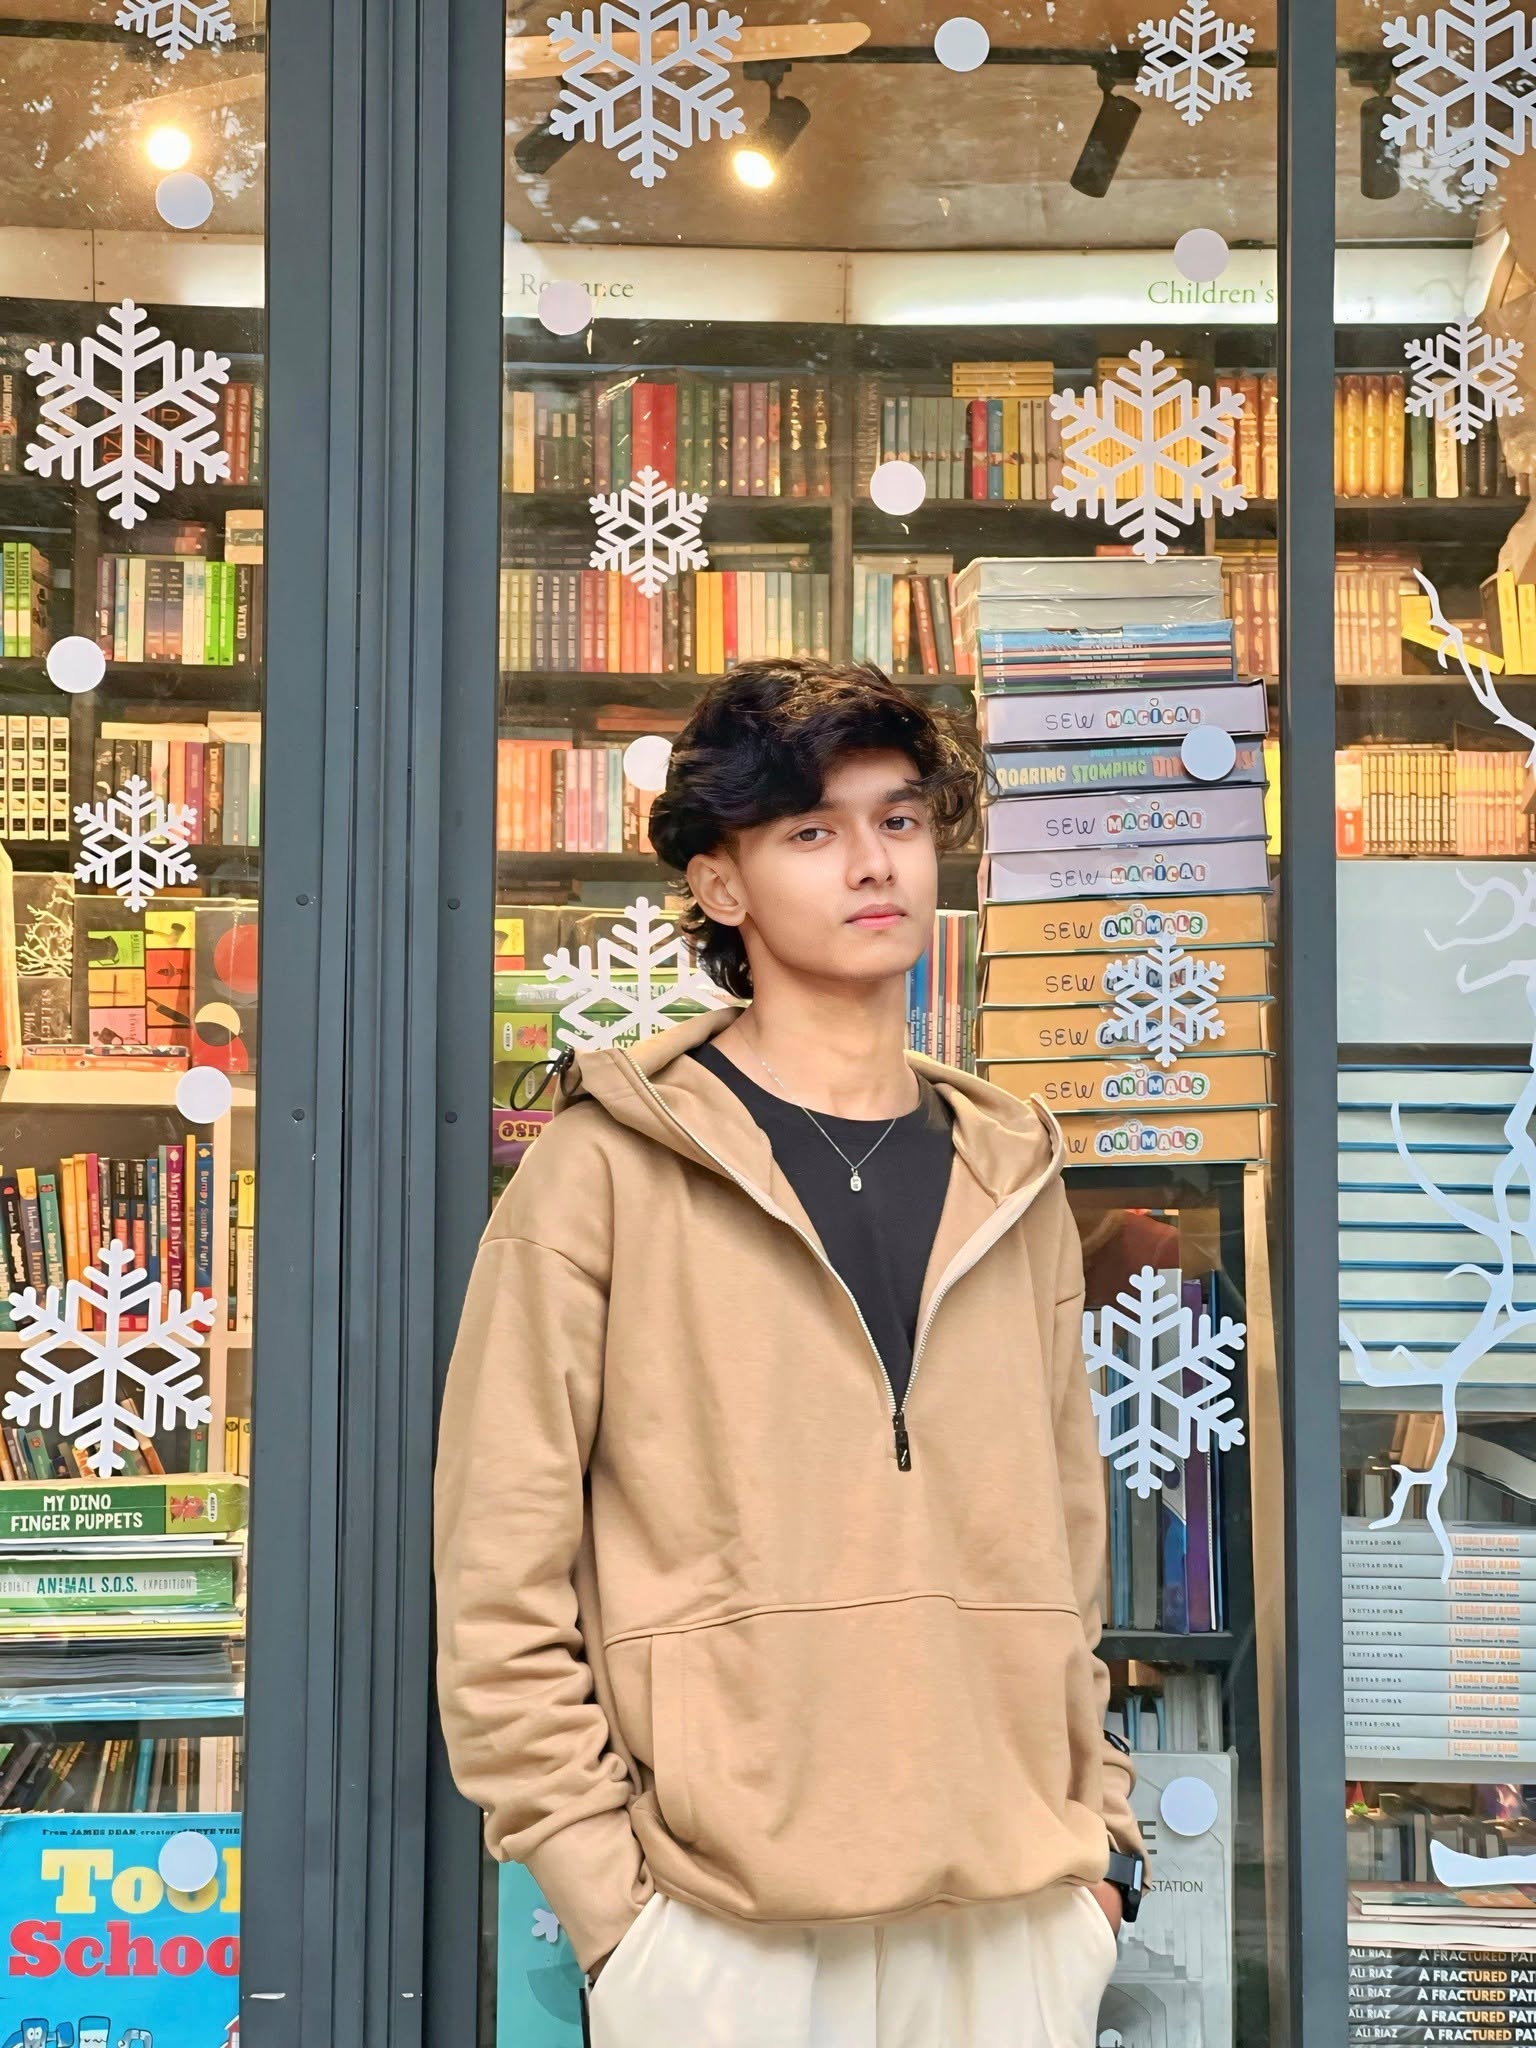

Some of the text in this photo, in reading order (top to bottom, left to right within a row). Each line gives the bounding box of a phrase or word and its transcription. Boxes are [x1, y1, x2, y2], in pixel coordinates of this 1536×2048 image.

[1147, 280, 1275, 304] Children's
[1045, 698, 1201, 730] SEW MAGICAL
[1071, 760, 1147, 784] STOMPING
[1046, 801, 1202, 836] SEW MAGICAL
[1050, 854, 1206, 888] SEW MAGICAL
[1043, 908, 1204, 941] SEW ANIMALS
[1045, 974, 1095, 993] SEW
[1039, 1028, 1089, 1047] SEW
[1045, 1068, 1206, 1099] SEW ANIMALS
[1099, 1123, 1199, 1152] ANIMALS
[168, 1172, 182, 1222] Magical
[199, 1171, 209, 1205] Bumpy
[168, 1226, 181, 1259] Fairy
[43, 1494, 112, 1512] MY DINO
[11, 1512, 143, 1532] FINGER PUPPETS
[37, 1577, 96, 1594] ANIMAL
[101, 1576, 138, 1593] S.O.S.
[144, 1578, 192, 1591] EXPEDITION
[1150, 1880, 1204, 1893] STATION
[1350, 1949, 1392, 1958] ALI RIAZ
[1418, 1950, 1429, 1961] A
[1433, 1951, 1506, 1962] FRACTURED
[1350, 1969, 1393, 1979] ALI RIAZ
[1418, 1968, 1430, 1981] A
[1433, 1970, 1507, 1983] FRACTURED
[1349, 1988, 1391, 1998] ALI RIAZ
[1417, 1988, 1428, 2000] A
[1432, 1989, 1506, 2001] FRACTURED
[1349, 2009, 1391, 2019] ALI RIAZ
[1417, 2009, 1428, 2022] A
[1431, 2010, 1505, 2023] FRACTURED
[1355, 2029, 1398, 2038] ALI RIAZ
[1424, 2028, 1435, 2040] A
[1438, 2028, 1512, 2041] FRACTURED
